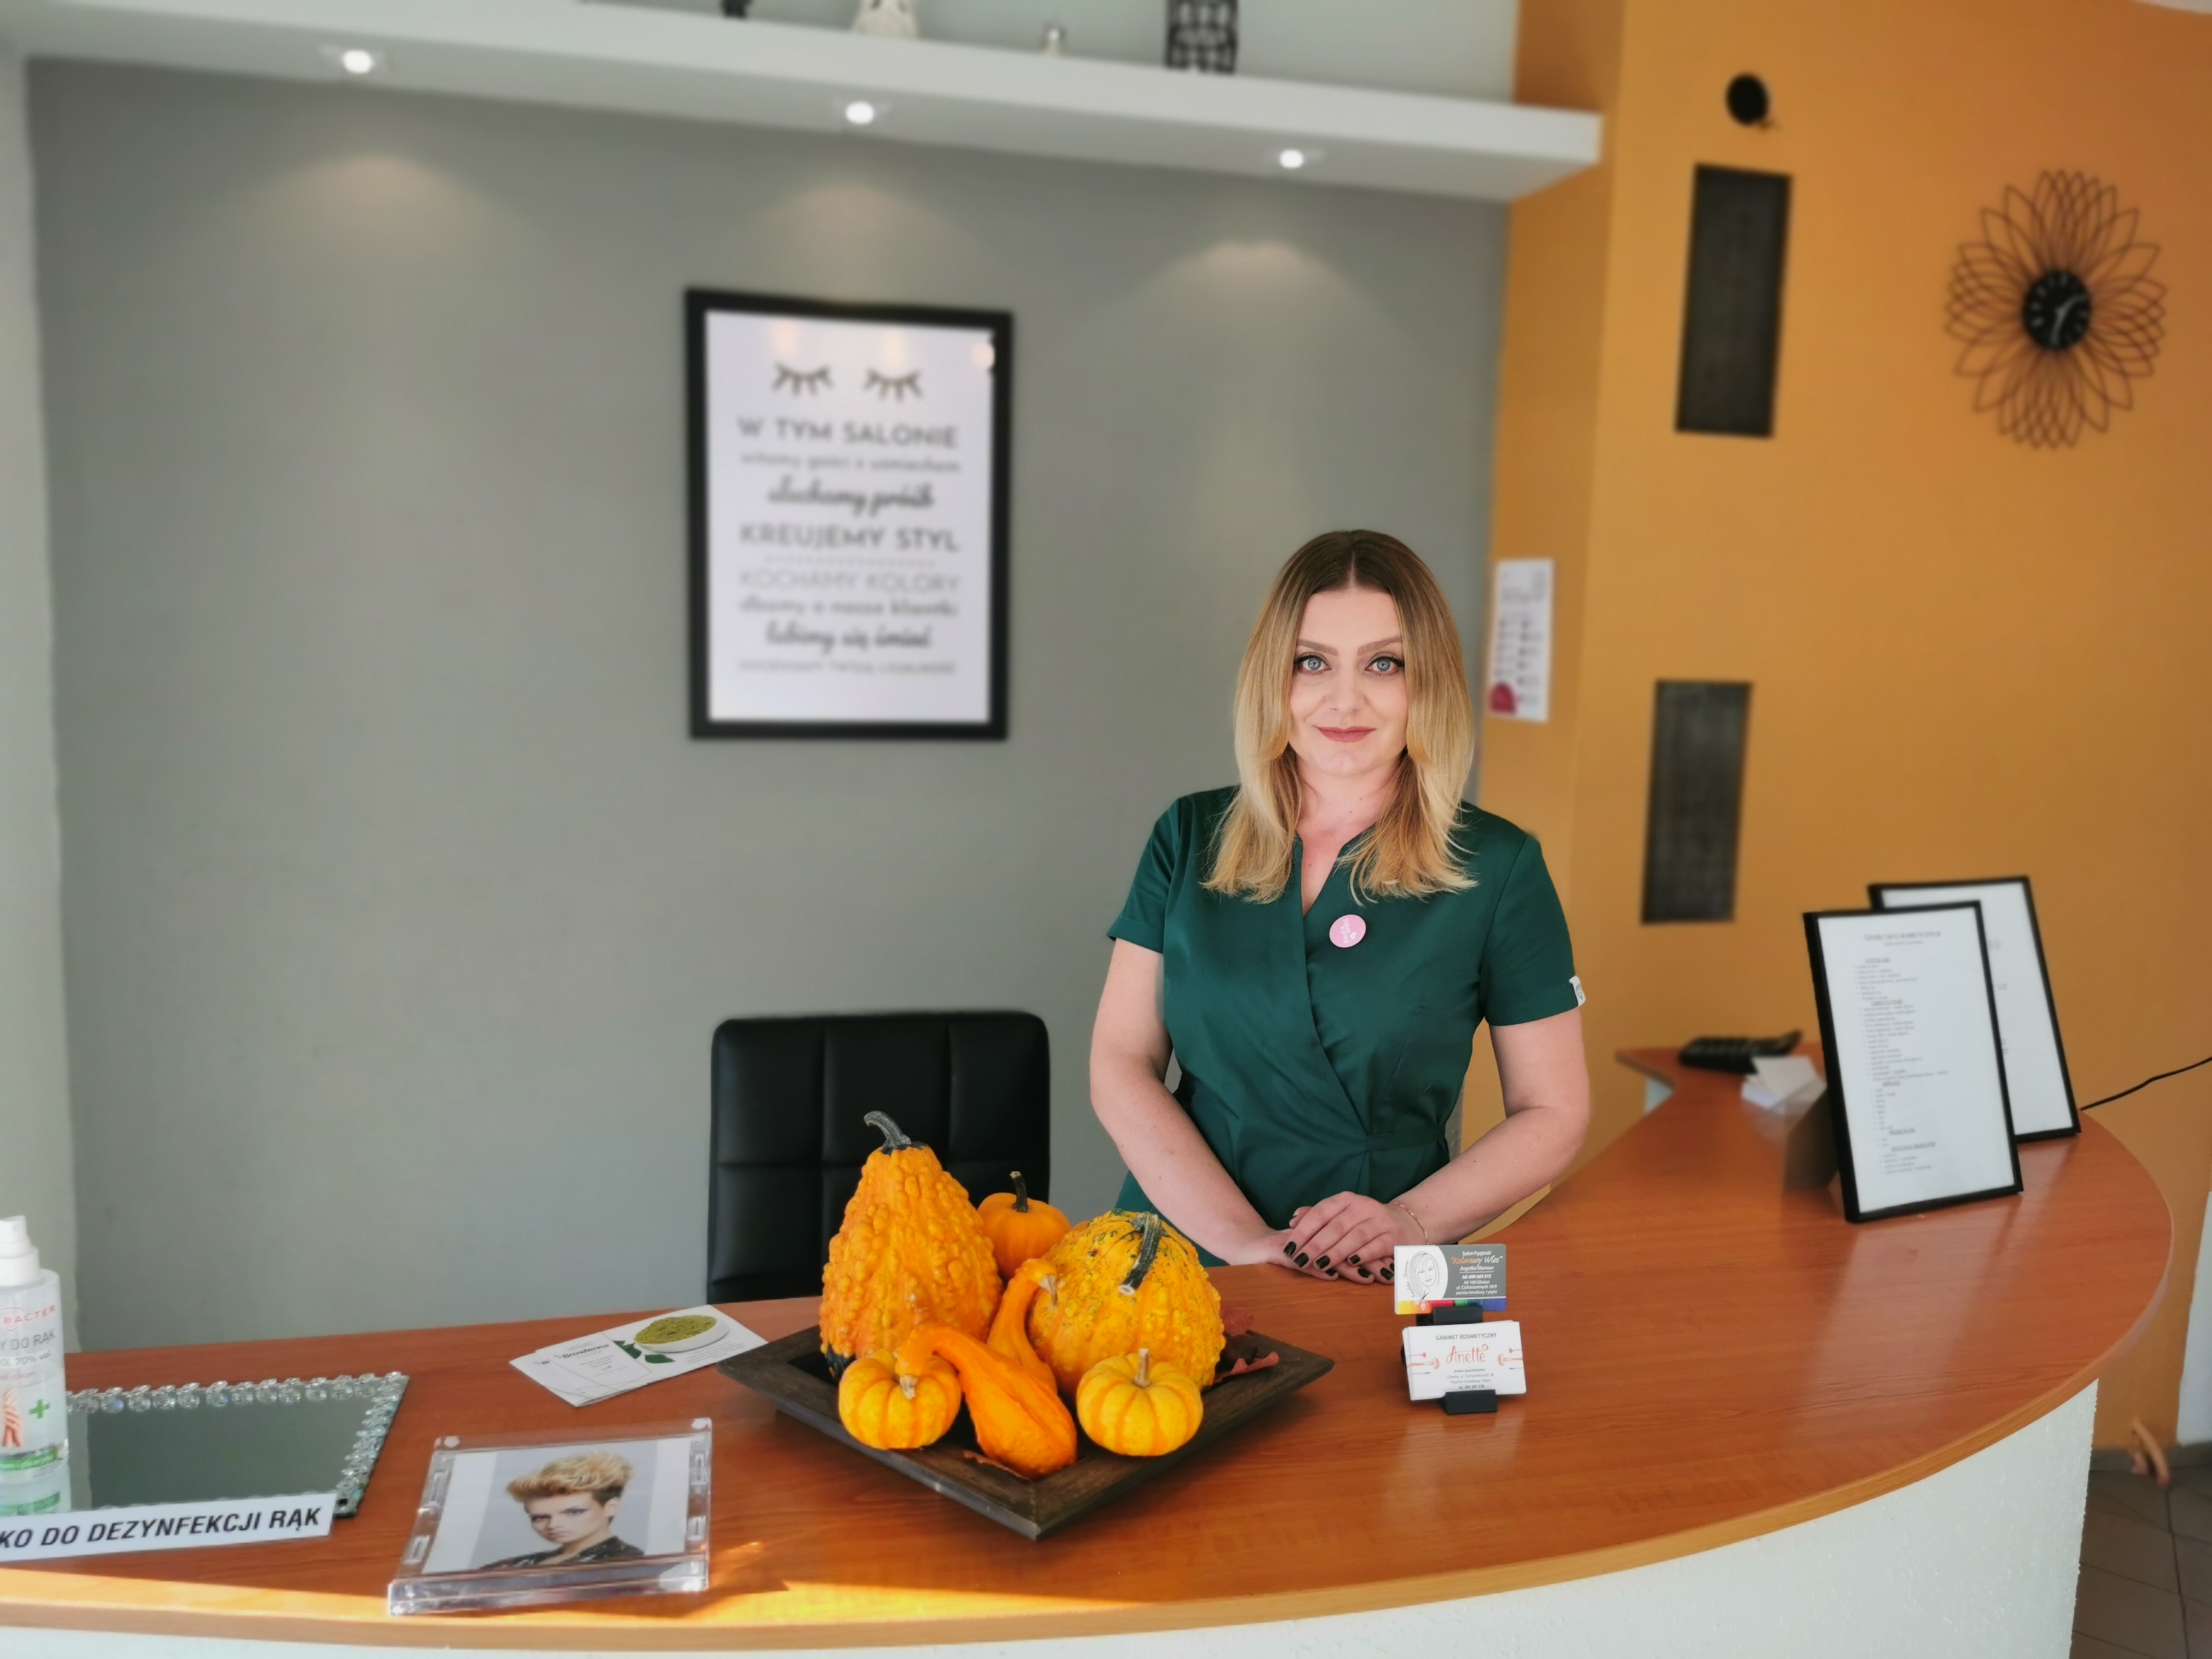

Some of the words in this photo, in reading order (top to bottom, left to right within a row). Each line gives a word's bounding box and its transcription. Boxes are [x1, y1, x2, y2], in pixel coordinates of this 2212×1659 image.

[737, 417, 764, 436] W
[776, 417, 831, 438] TYM
[843, 421, 958, 449] SALONIE
[740, 524, 885, 550] KREUJEMY
[896, 528, 959, 552] STYL
[740, 568, 858, 589] KOCHAMY
[866, 571, 960, 594] KOLORY
[4, 1305, 55, 1324] BACTER
[11, 1337, 29, 1350] DO
[1446, 1343, 1489, 1364] Anette
[41, 1526, 80, 1546] DO
[87, 1512, 262, 1542] DEZYNFEKCJI
[269, 1507, 322, 1532] RĄK
